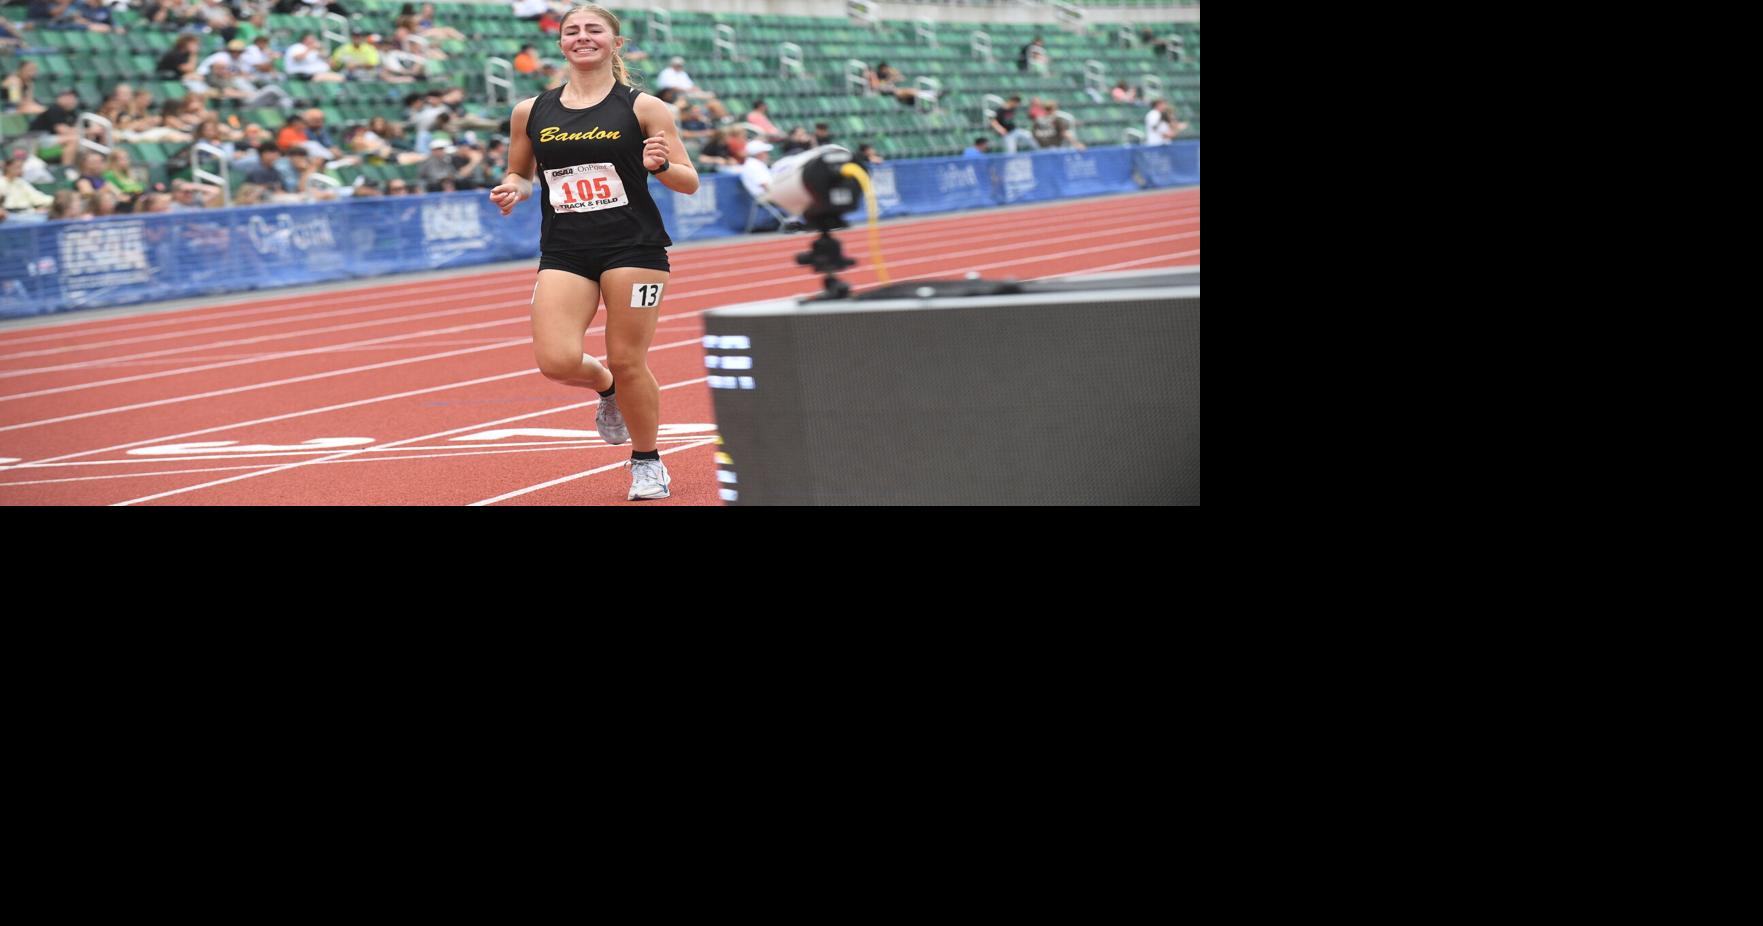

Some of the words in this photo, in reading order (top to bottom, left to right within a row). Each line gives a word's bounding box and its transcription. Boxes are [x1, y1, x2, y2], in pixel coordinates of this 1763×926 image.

[539, 126, 622, 144] Bandon
[562, 177, 611, 204] 105
[595, 197, 618, 205] FIELD
[638, 284, 659, 306] 13
